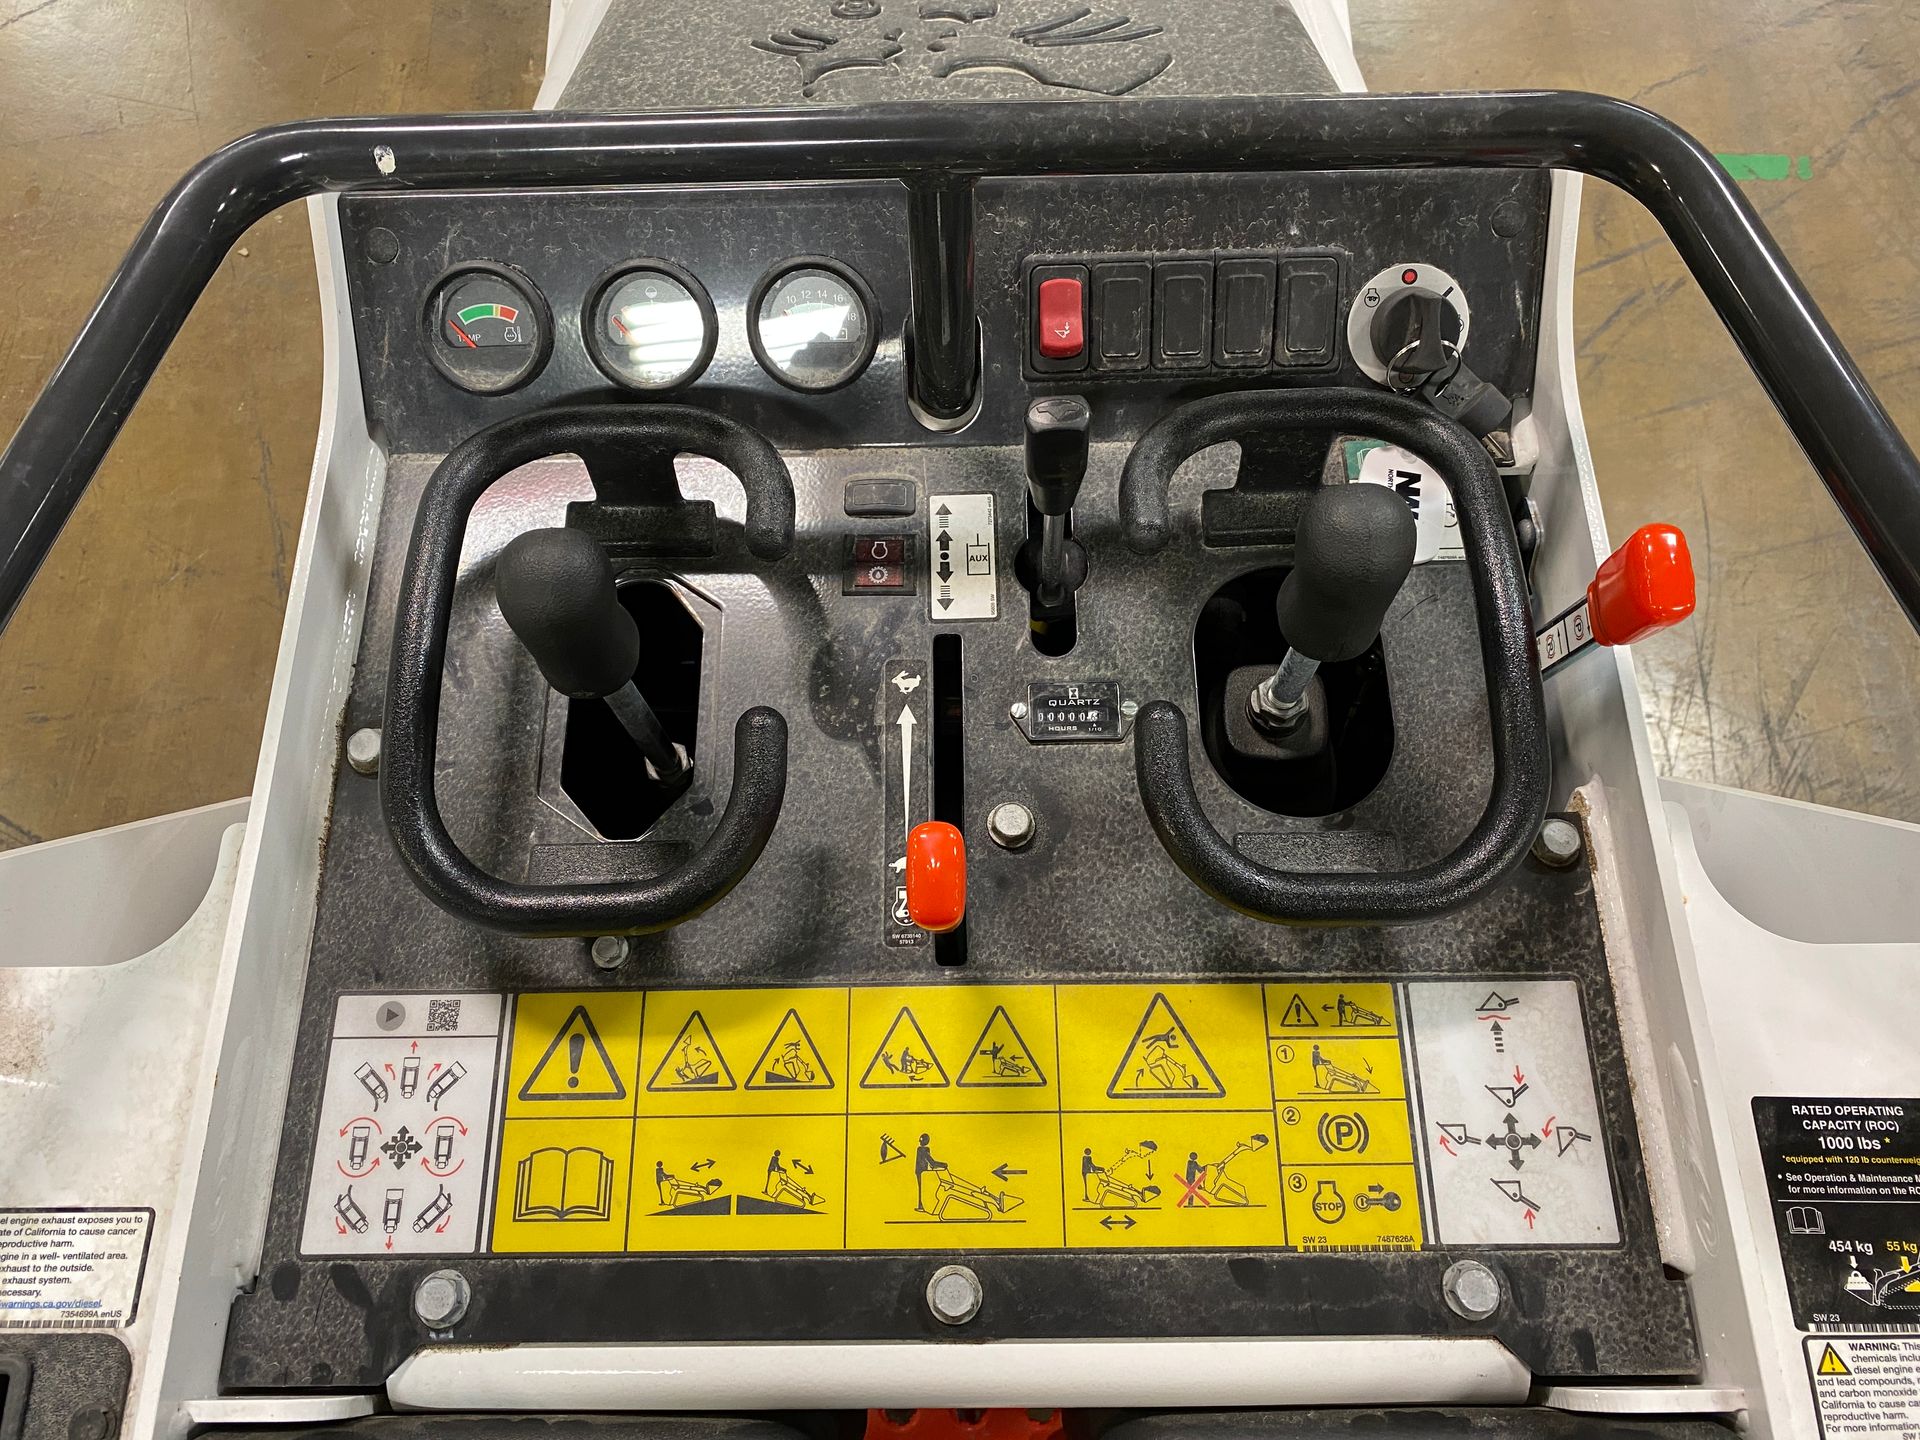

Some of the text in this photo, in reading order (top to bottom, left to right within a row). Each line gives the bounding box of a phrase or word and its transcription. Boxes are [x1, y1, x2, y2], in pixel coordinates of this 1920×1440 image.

[786, 290, 844, 304] 10 12 14 16
[847, 312, 856, 321] 18
[457, 334, 481, 342] TMP
[1048, 698, 1100, 707] QUARTZ
[1792, 1105, 1904, 1116] RATED OPERATING
[1802, 1120, 1900, 1132] CAPACITY (ROC)
[1335, 1122, 1354, 1146] P
[1818, 1136, 1882, 1150] 1000 lbs
[1825, 1156, 1843, 1164] with
[1785, 1172, 1802, 1182] See
[1804, 1173, 1848, 1183] Operation
[1850, 1174, 1856, 1182] &
[1858, 1174, 1914, 1182] Maintenance
[1788, 1184, 1800, 1194] for
[1826, 1186, 1878, 1194] information
[1892, 1186, 1908, 1194] the
[1316, 1202, 1342, 1212] STOP
[10, 1216, 39, 1226] engine
[41, 1216, 76, 1224] exhaust
[77, 1216, 114, 1225] exposes
[116, 1217, 132, 1225] you
[14, 1228, 24, 1236] of
[25, 1228, 66, 1236] California
[1302, 1235, 1415, 1244] SW 23 7487626A
[1829, 1240, 1918, 1256] 454 kg 55 kg
[21, 1252, 30, 1260] in
[40, 1252, 60, 1260] well-
[62, 1252, 106, 1260] ventilated
[32, 1264, 42, 1272] to
[44, 1264, 58, 1272] the
[60, 1264, 94, 1272] outside.
[2, 1276, 72, 1286] exhaust system.
[1813, 1314, 1840, 1322] SW 23
[1848, 1342, 1900, 1351] WARNING:
[1852, 1354, 1898, 1362] chemicals
[1854, 1366, 1881, 1374] diesel
[1883, 1365, 1914, 1376] engine
[1817, 1378, 1834, 1386] and
[1836, 1377, 1856, 1386] lead
[1858, 1376, 1916, 1387] compounds,
[1820, 1388, 1918, 1398] and carbon monoxide
[1821, 1400, 1866, 1410] California
[1867, 1400, 1877, 1409] to
[1878, 1400, 1906, 1408] cause
[1824, 1411, 1910, 1423] reproductive harm.
[1826, 1424, 1842, 1432] For
[1869, 1422, 1920, 1432] information
